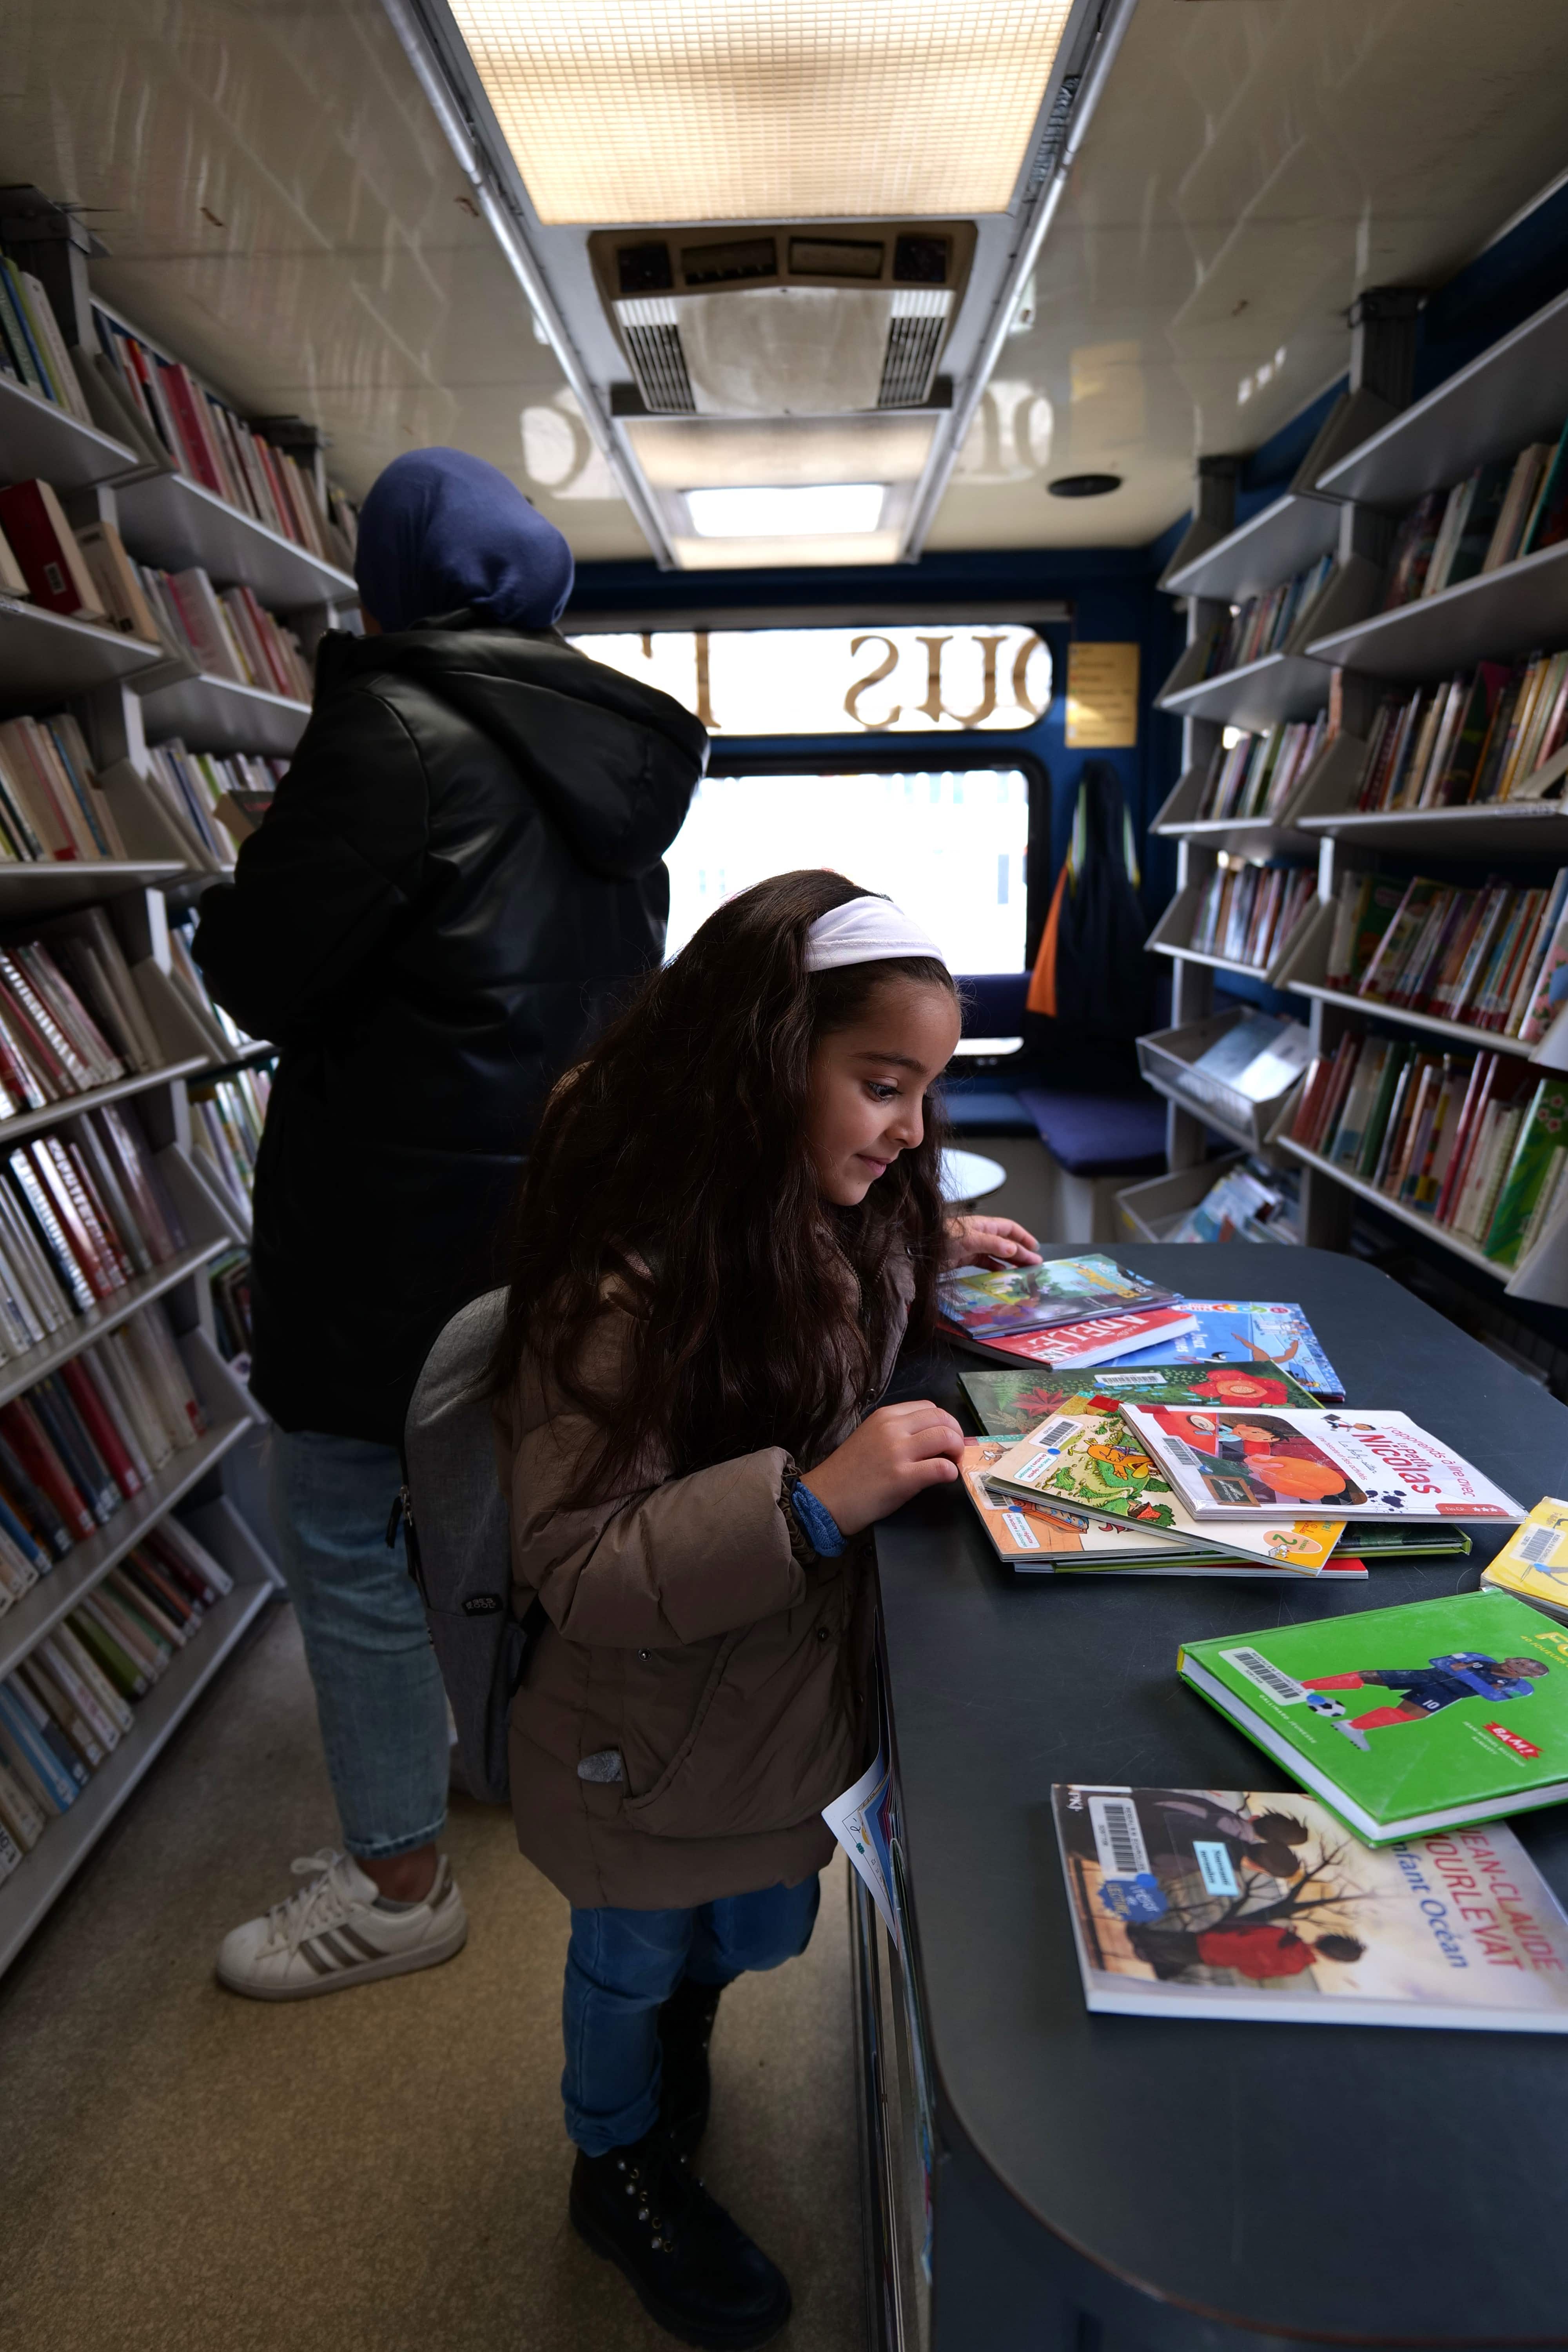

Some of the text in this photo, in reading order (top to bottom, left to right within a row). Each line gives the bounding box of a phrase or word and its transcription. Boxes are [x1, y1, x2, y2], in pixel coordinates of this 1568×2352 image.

[1352, 1434, 1442, 1494] Nicolas
[1441, 1459, 1456, 1468] à
[1446, 1465, 1465, 1477] lire
[1457, 1479, 1475, 1497] avec
[1272, 1534, 1298, 1545] 2
[1422, 1699, 1441, 1710] 10
[1492, 1727, 1534, 1754] BAM!
[1392, 1843, 1469, 1969] nfant Océan
[1457, 1829, 1565, 1971] JEAN-CLAUDE
